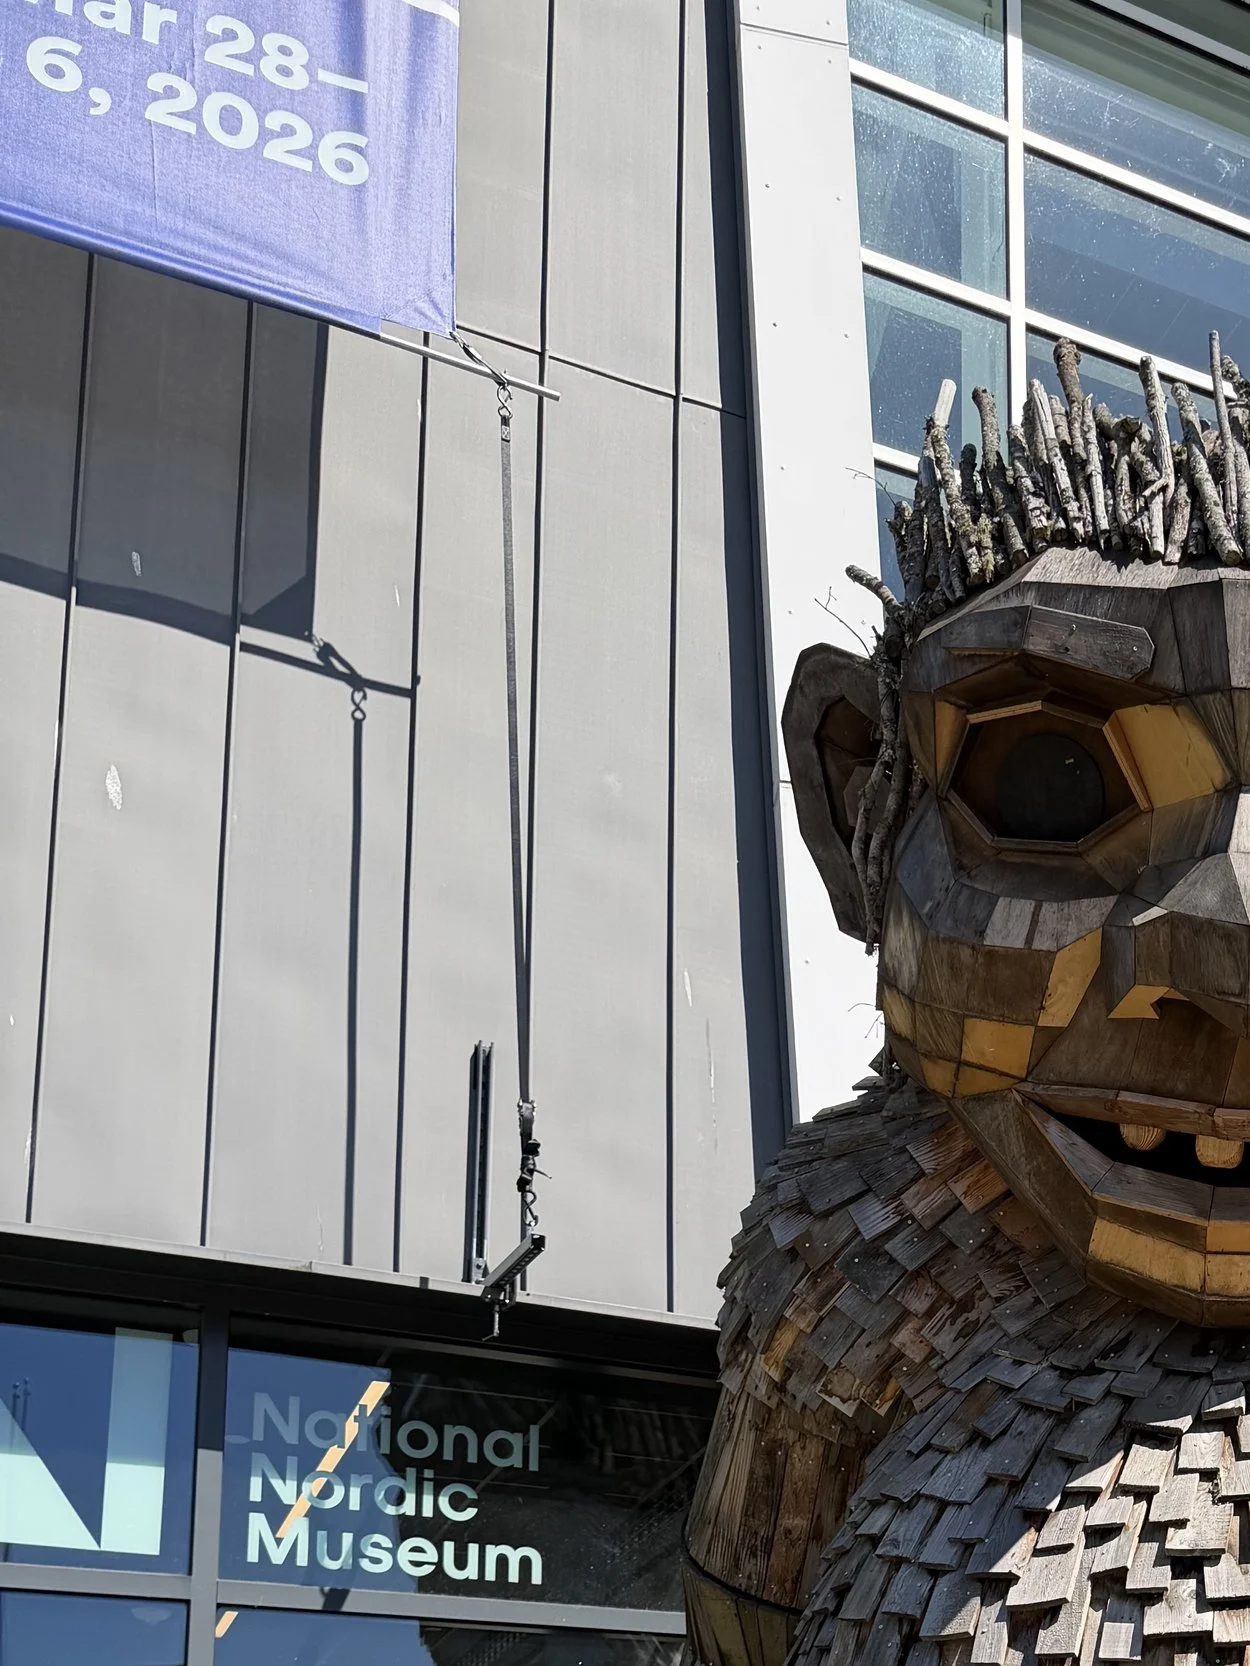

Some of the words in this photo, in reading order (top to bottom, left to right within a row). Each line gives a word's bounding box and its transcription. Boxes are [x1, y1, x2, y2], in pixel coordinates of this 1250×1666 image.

[25, 0, 177, 45] ar
[26, 36, 112, 116] 6,
[145, 72, 369, 186] 2026
[252, 1392, 540, 1472] National
[249, 1452, 479, 1522] Nordic
[247, 1512, 543, 1585] Museum
